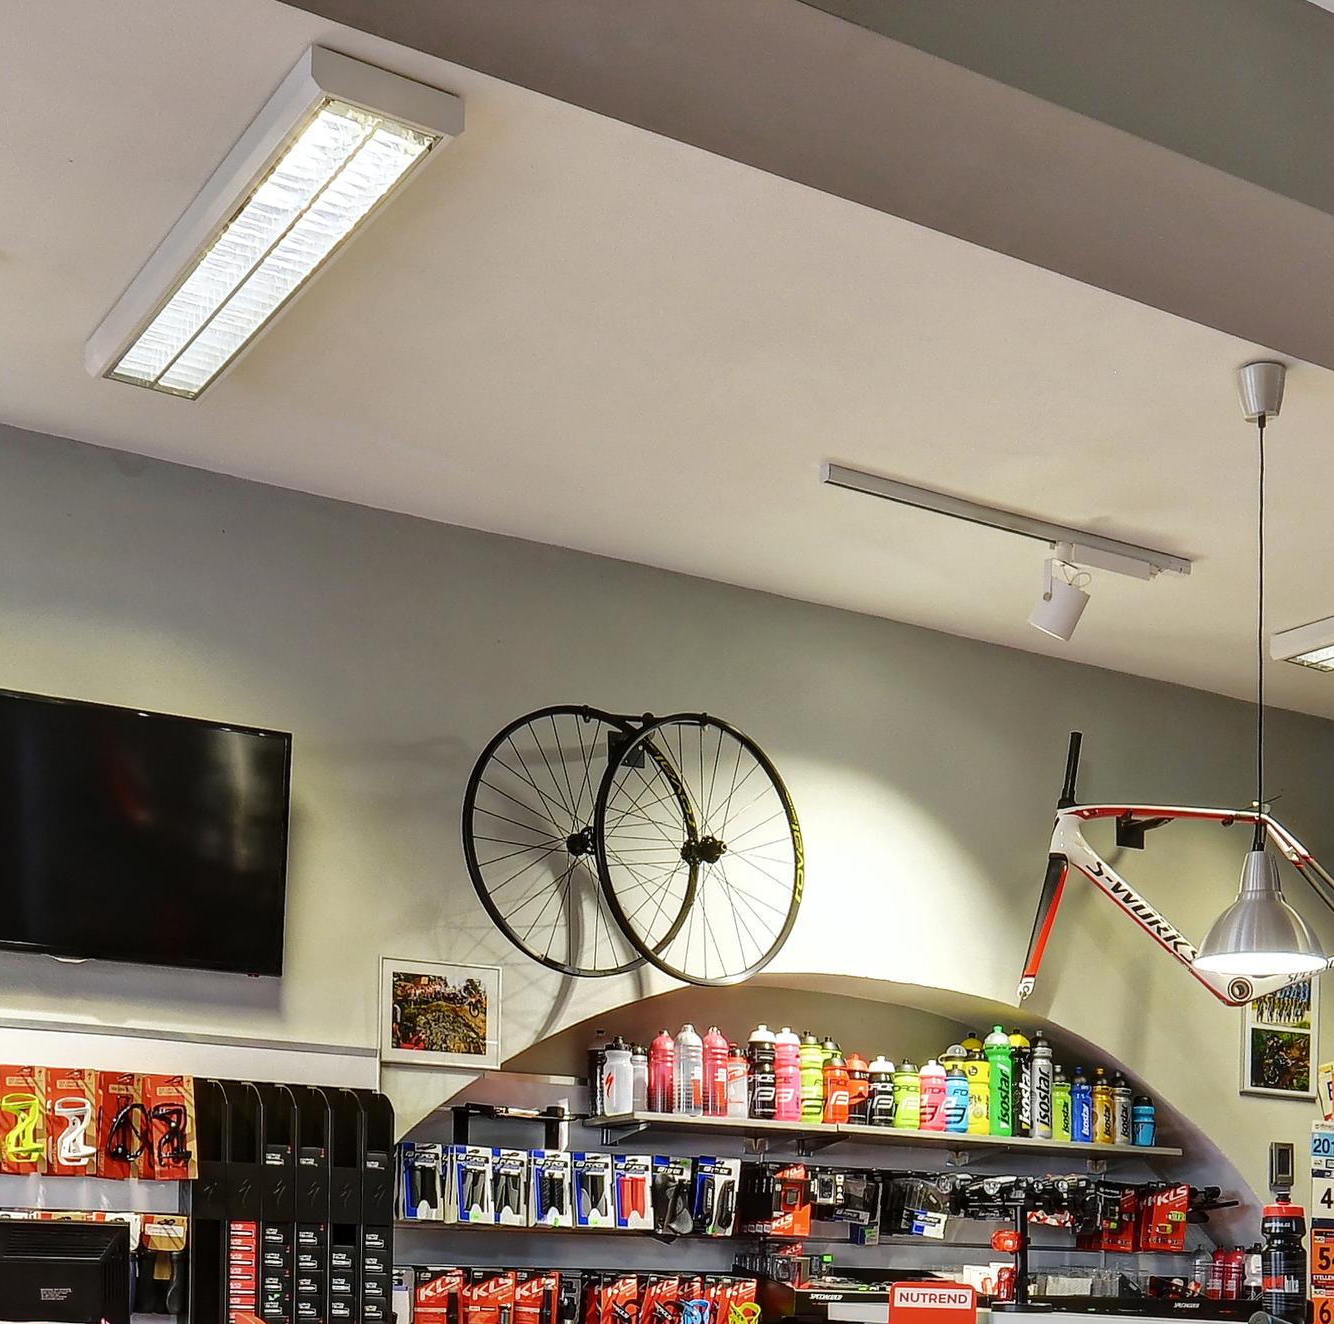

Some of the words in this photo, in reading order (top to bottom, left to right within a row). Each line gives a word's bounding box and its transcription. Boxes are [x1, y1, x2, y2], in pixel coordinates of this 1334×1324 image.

[1037, 1067, 1052, 1127] isostar
[1155, 1184, 1188, 1206] KLS
[899, 1292, 968, 1305] NUTREND
